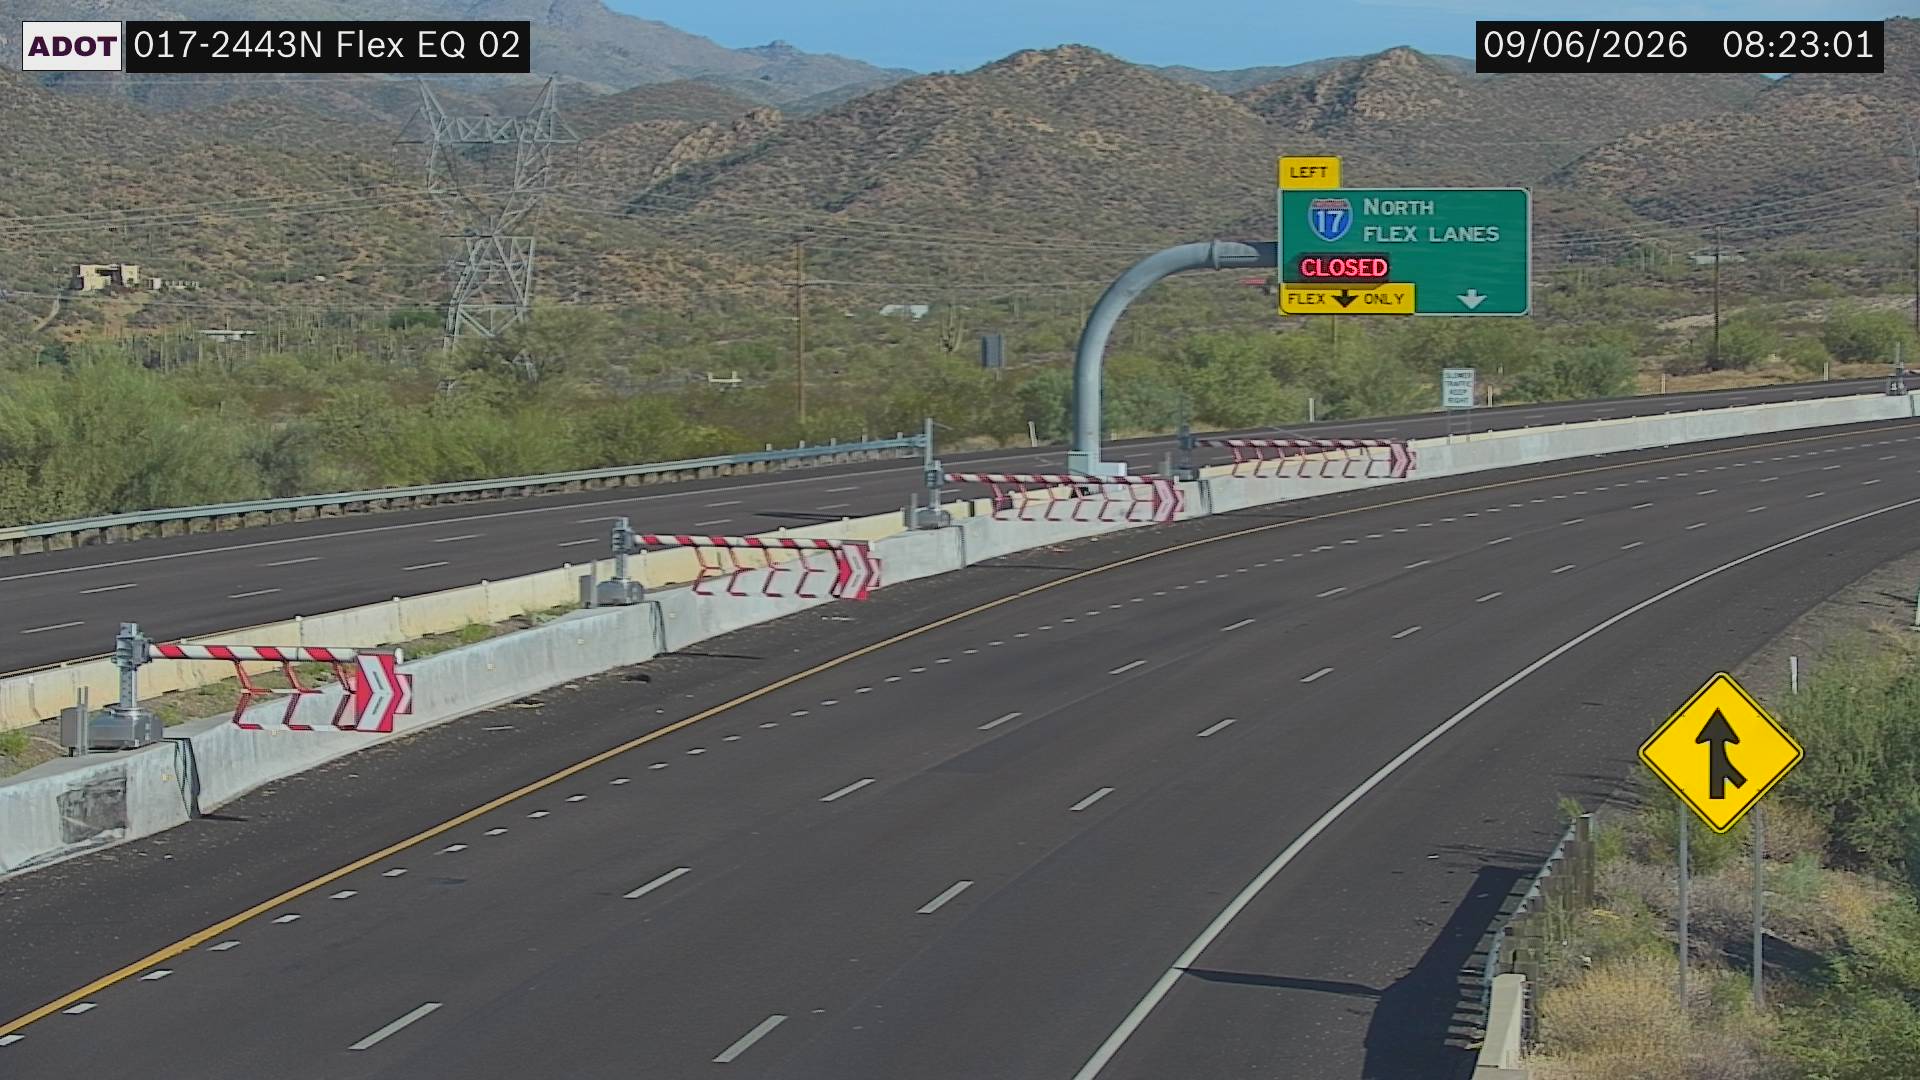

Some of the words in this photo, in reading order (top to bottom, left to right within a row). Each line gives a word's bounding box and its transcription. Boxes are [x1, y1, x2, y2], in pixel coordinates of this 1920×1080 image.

[1290, 166, 1328, 179] LEFT
[1363, 198, 1435, 216] NORTH
[1317, 210, 1344, 233] 17
[1363, 226, 1417, 242] FLEX
[1428, 226, 1500, 242] LANES
[1300, 258, 1389, 277] CLOSED
[1288, 293, 1326, 305] FLEX
[1363, 293, 1405, 305] ONLY
